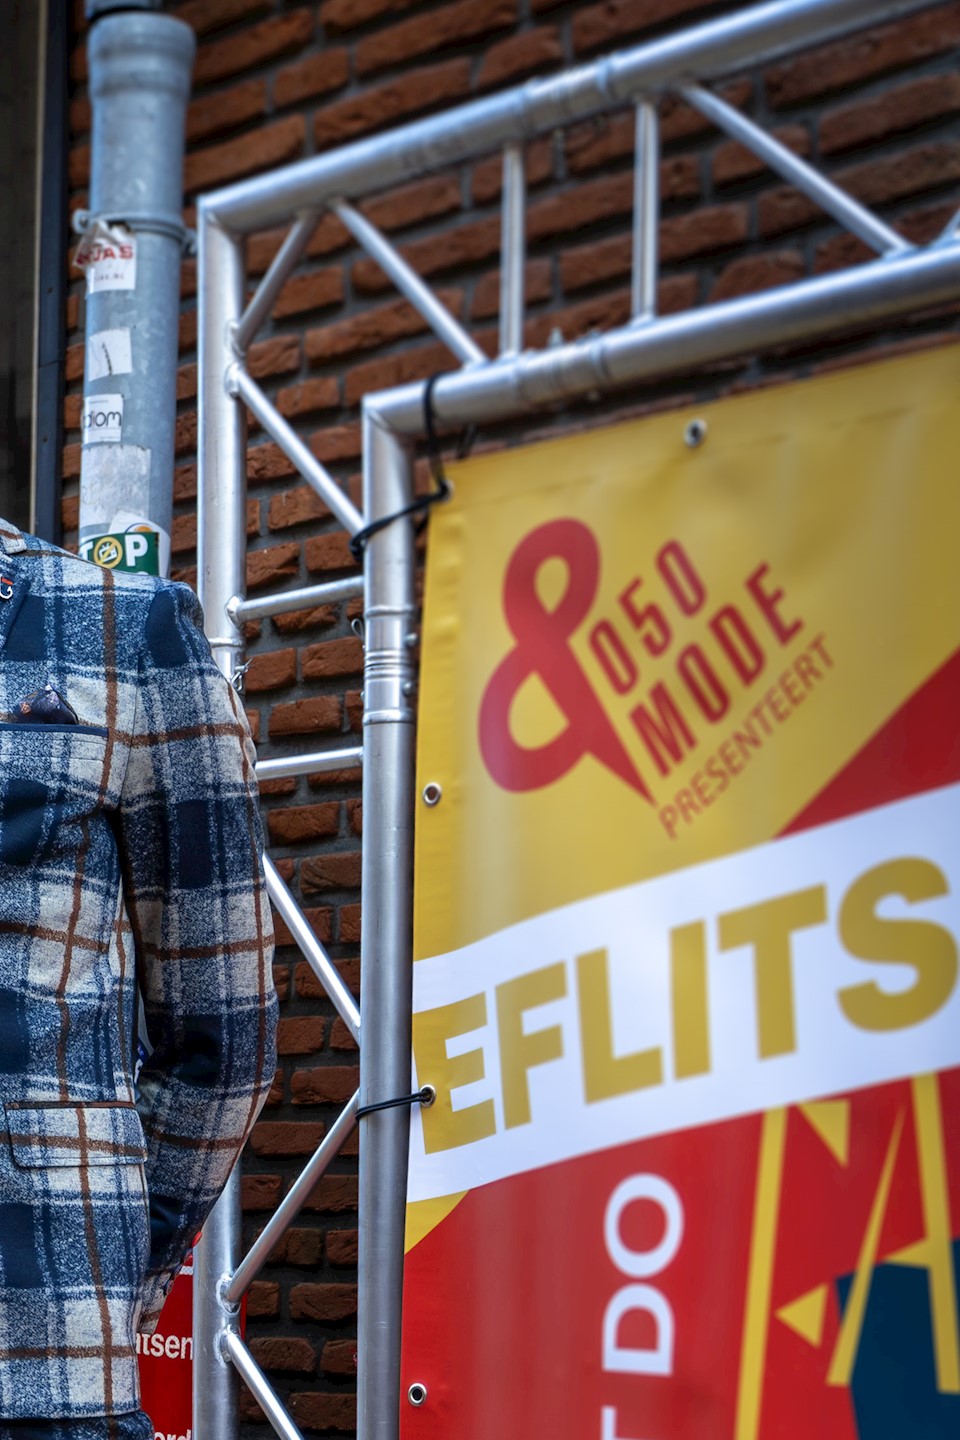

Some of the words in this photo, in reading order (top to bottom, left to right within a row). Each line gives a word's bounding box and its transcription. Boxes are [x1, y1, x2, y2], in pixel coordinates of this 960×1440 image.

[588, 538, 708, 698] 050
[627, 559, 805, 779] MODE
[657, 632, 835, 841] PRESENTEERT
[412, 856, 959, 1155] EFLITS
[601, 1172, 685, 1377] DO
